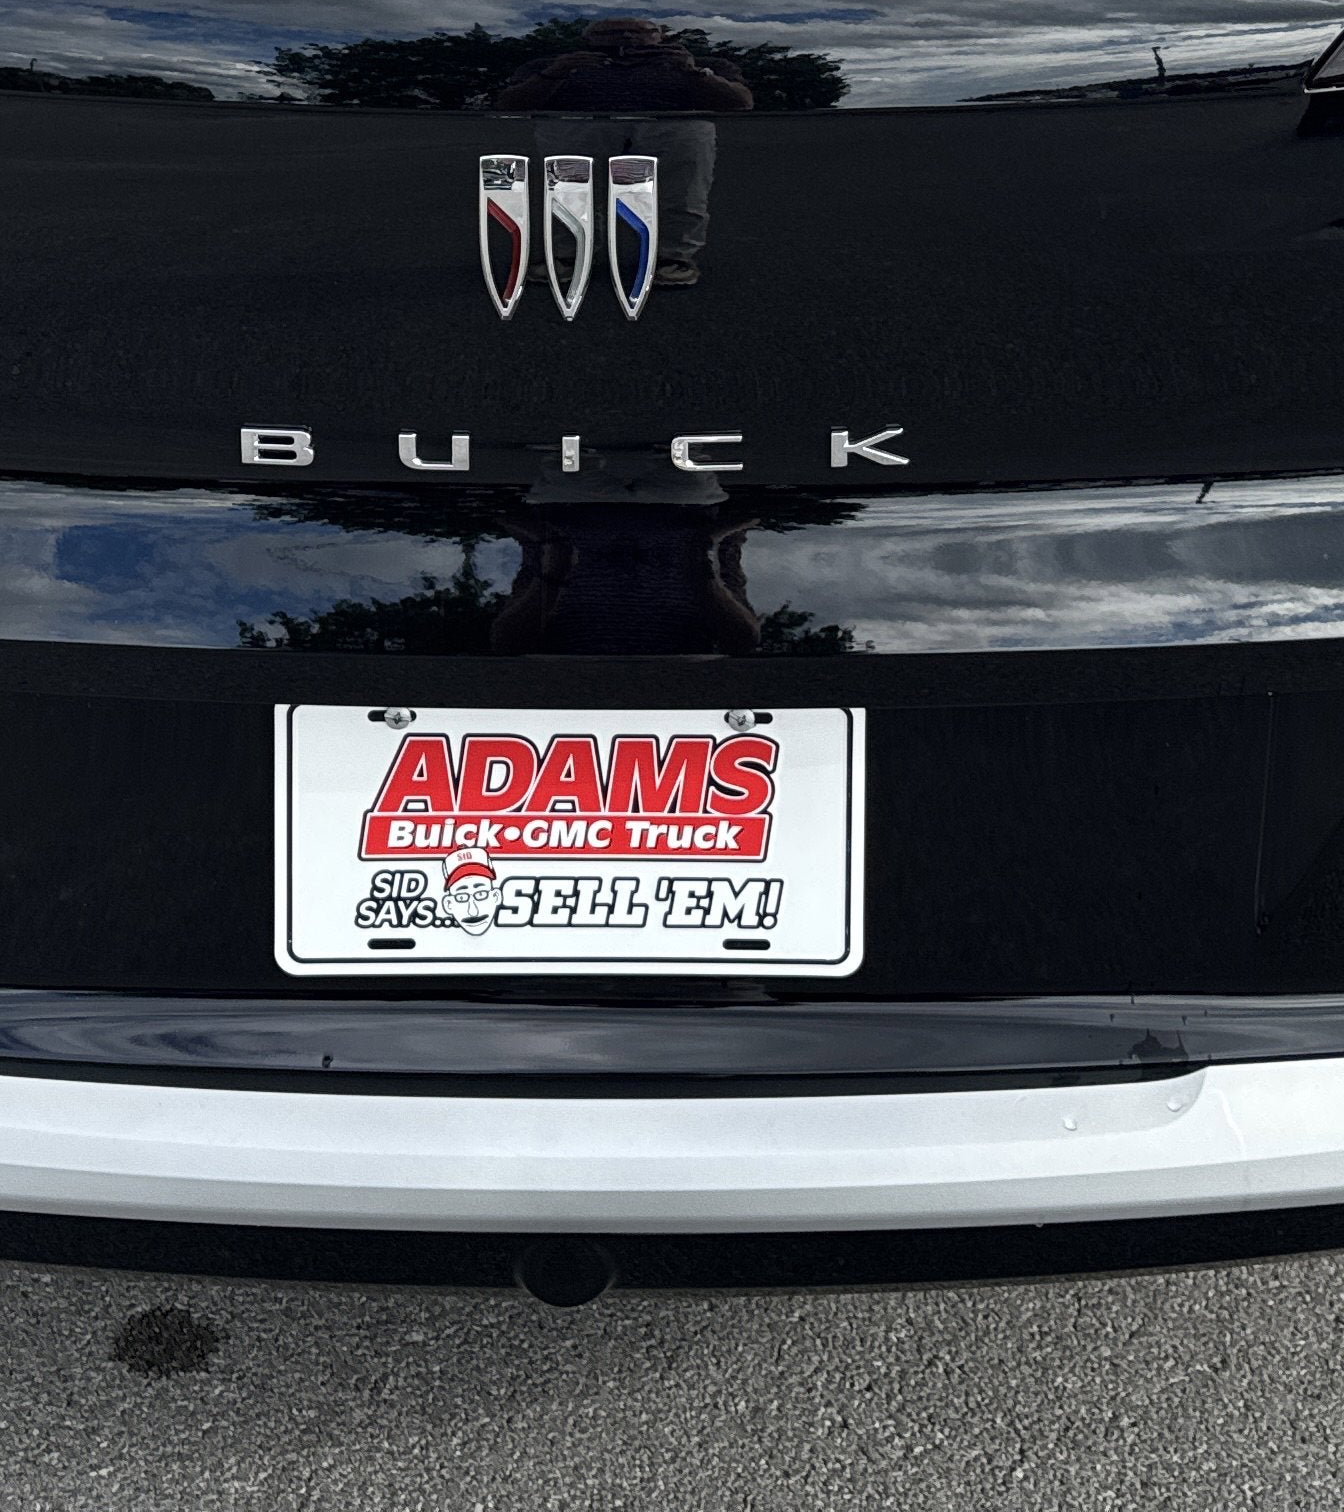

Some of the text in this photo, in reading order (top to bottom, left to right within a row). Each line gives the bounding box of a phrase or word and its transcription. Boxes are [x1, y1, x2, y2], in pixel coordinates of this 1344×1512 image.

[240, 425, 911, 473] BUICK
[373, 734, 779, 816] ADAMS
[625, 819, 744, 851] Truck
[456, 851, 473, 862] SID
[371, 870, 429, 900] SID
[495, 876, 784, 930] SELL 'EM!
